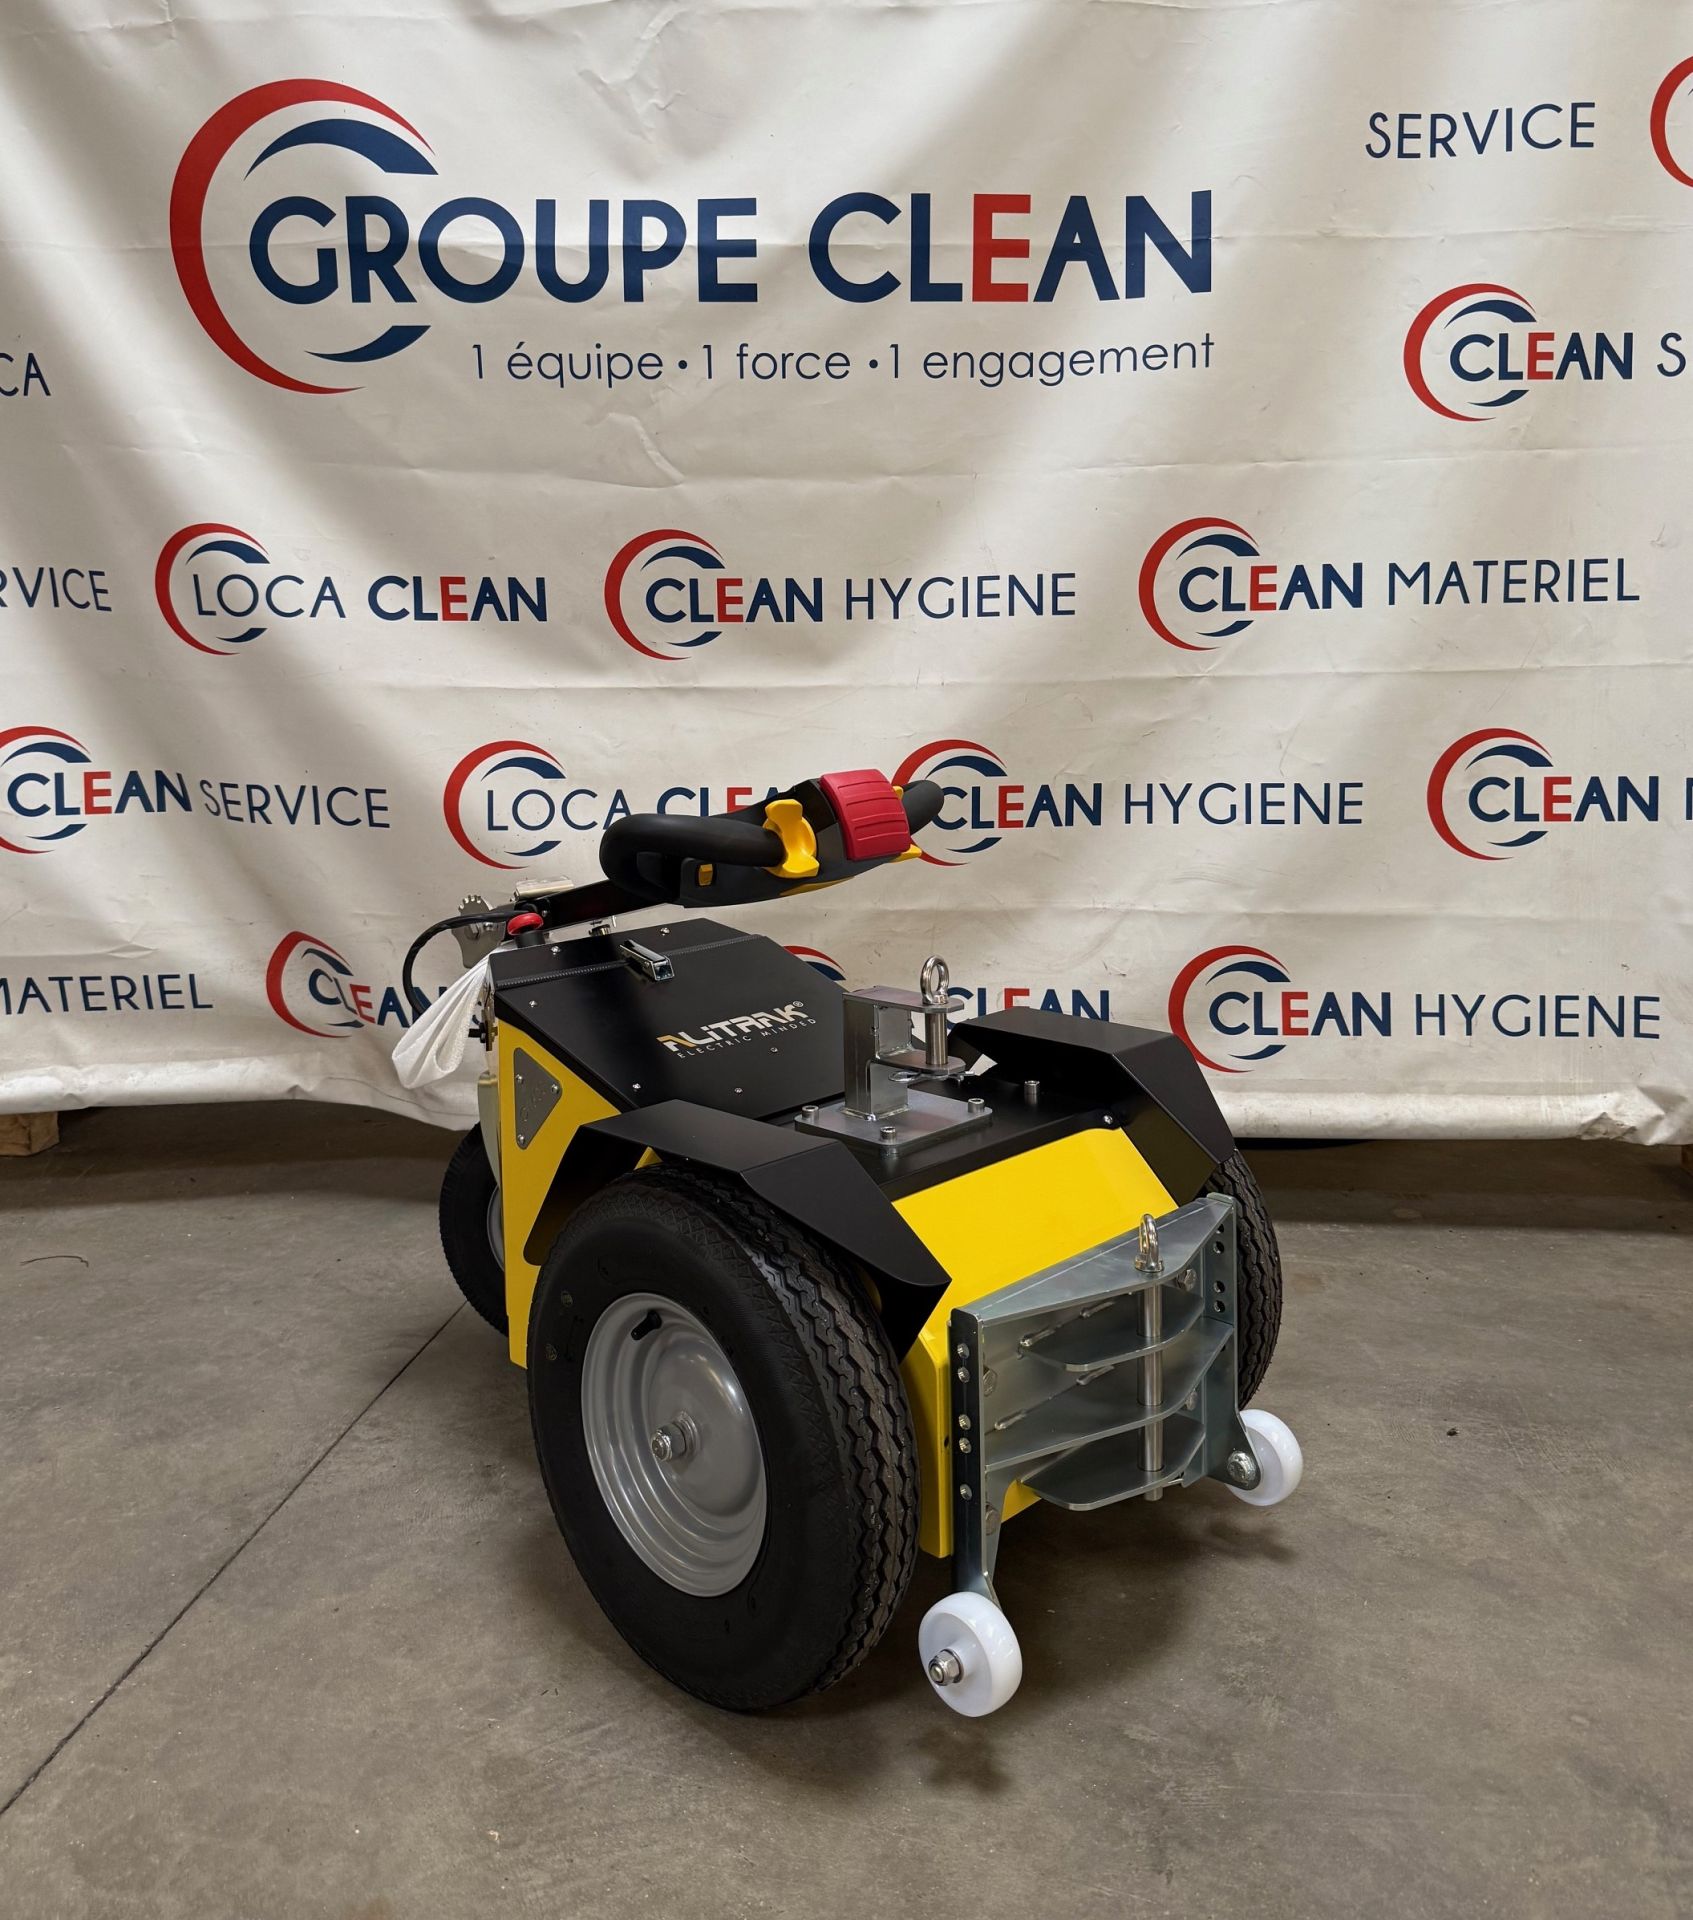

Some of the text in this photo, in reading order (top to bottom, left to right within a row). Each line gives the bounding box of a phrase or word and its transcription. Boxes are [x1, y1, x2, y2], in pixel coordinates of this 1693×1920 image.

[1366, 102, 1596, 159] SERVICE
[249, 190, 1212, 305] GROUPE CLEAN
[472, 333, 1215, 389] 1 équipe 1 force 1 engagement
[1450, 332, 1687, 382] CLEAN S
[192, 573, 548, 623] LOCA CLEAN
[645, 572, 1076, 624] CLEAN HYGIENE
[1179, 557, 1640, 613] CLEAN MATERIEL
[7, 769, 391, 829] CLEAN SERVICE
[487, 788, 628, 832] LOCA
[930, 782, 1364, 830] CLEAN HYGIENE
[1468, 775, 1660, 823] CLEAN
[677, 1018, 817, 1059] ELECTRIC MINDED
[1208, 991, 1661, 1040] CLEAN HYGIENE
